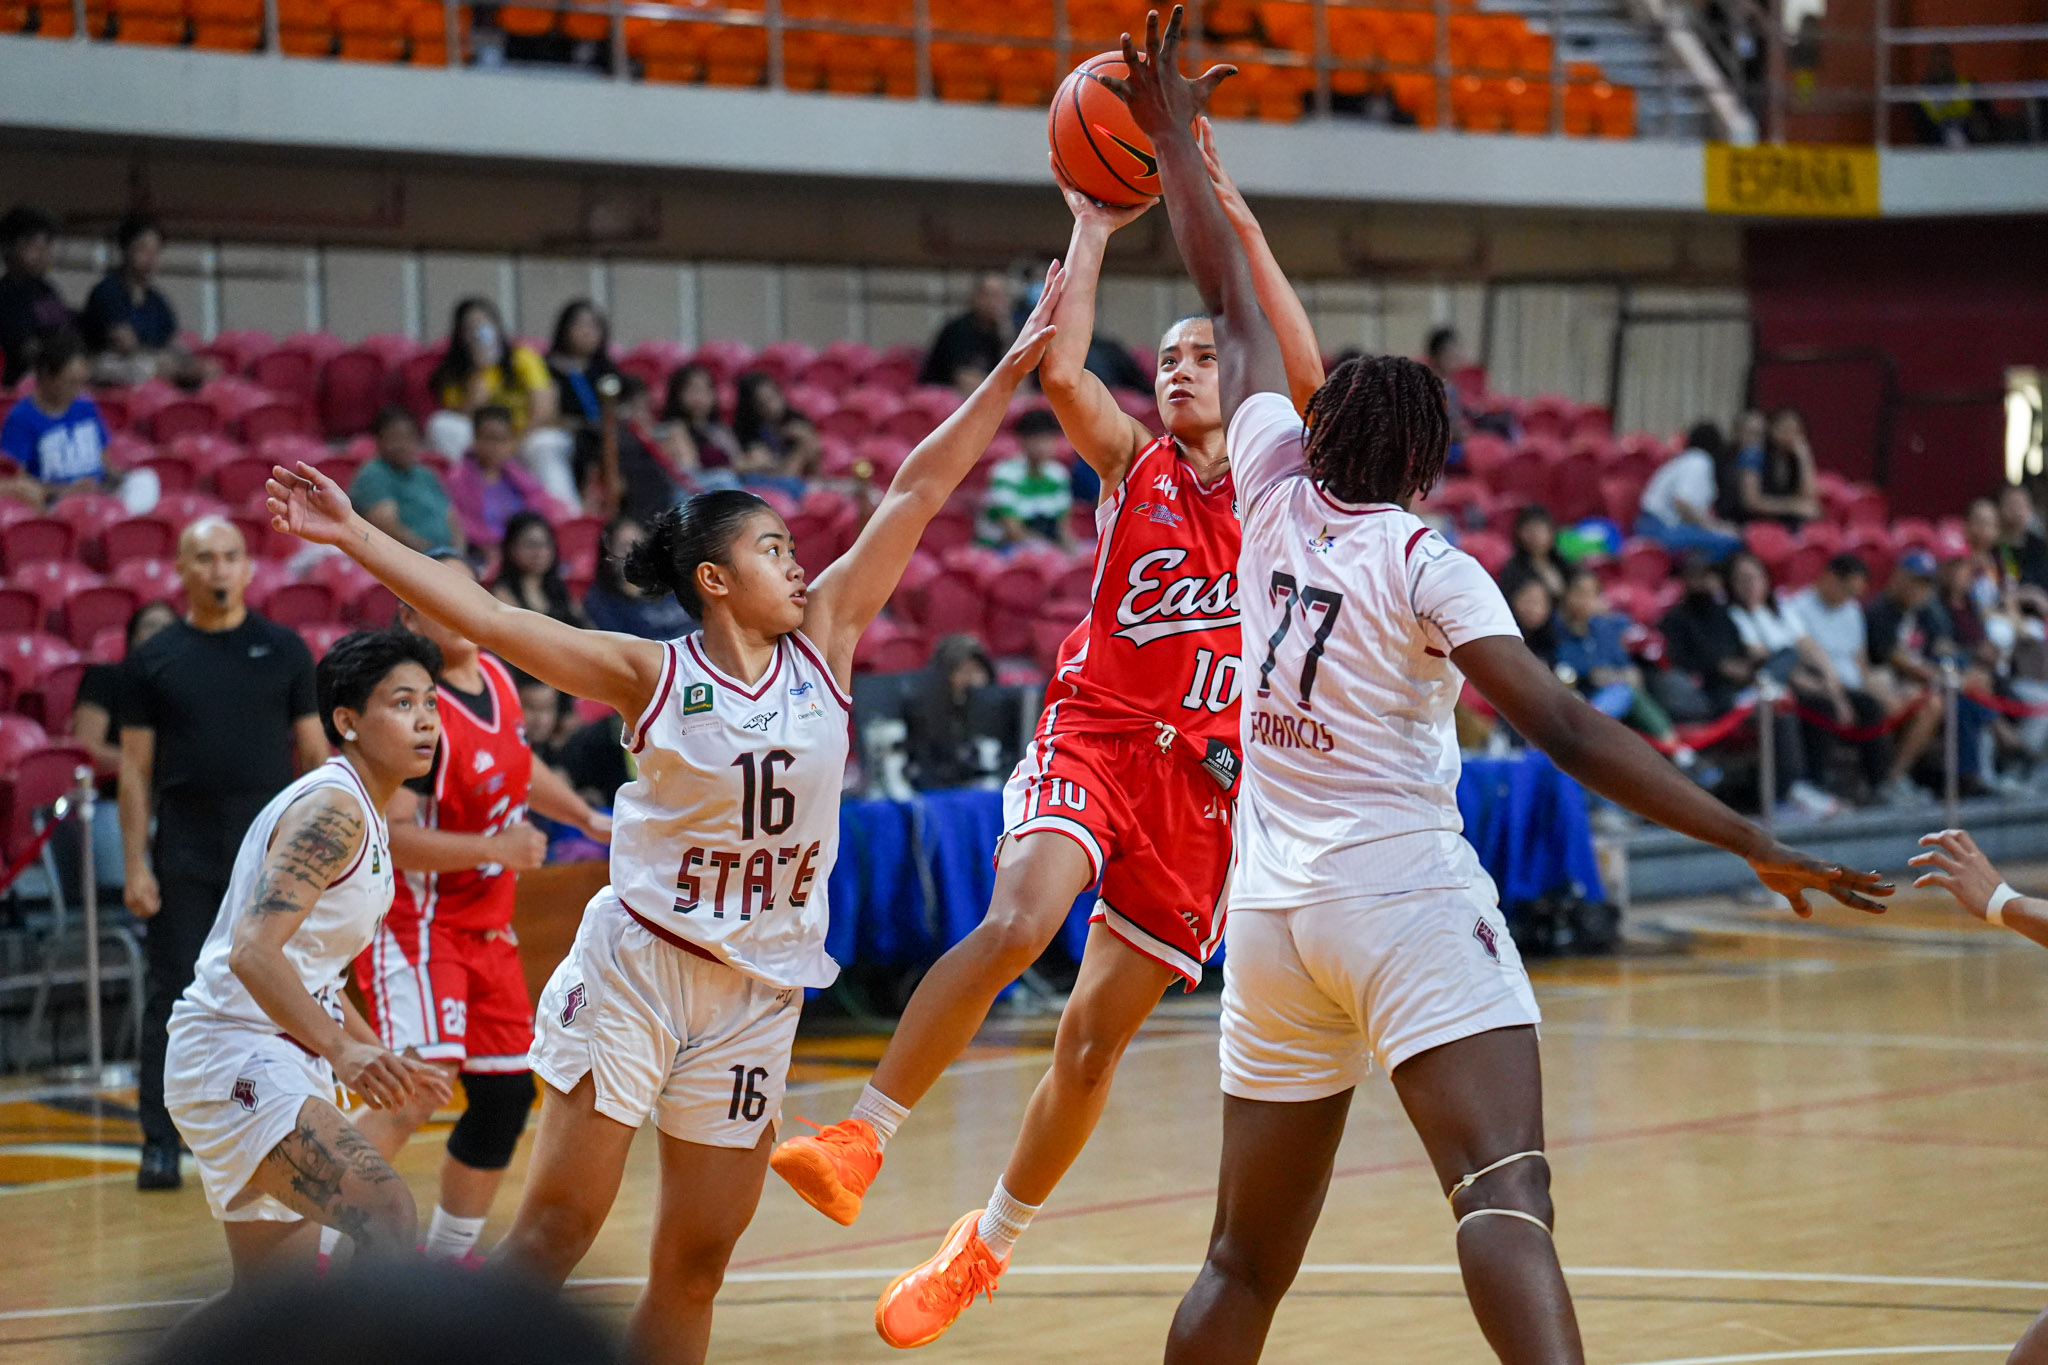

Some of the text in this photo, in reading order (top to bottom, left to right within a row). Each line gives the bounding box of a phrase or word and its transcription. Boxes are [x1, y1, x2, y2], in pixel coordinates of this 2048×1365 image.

[1116, 547, 1241, 626] Eas
[1181, 648, 1243, 713] 10
[1257, 571, 1343, 711] 77
[1250, 711, 1334, 753] FRANCIS
[730, 749, 796, 840] 16
[673, 840, 821, 921] STATE
[728, 1064, 769, 1122] 16
